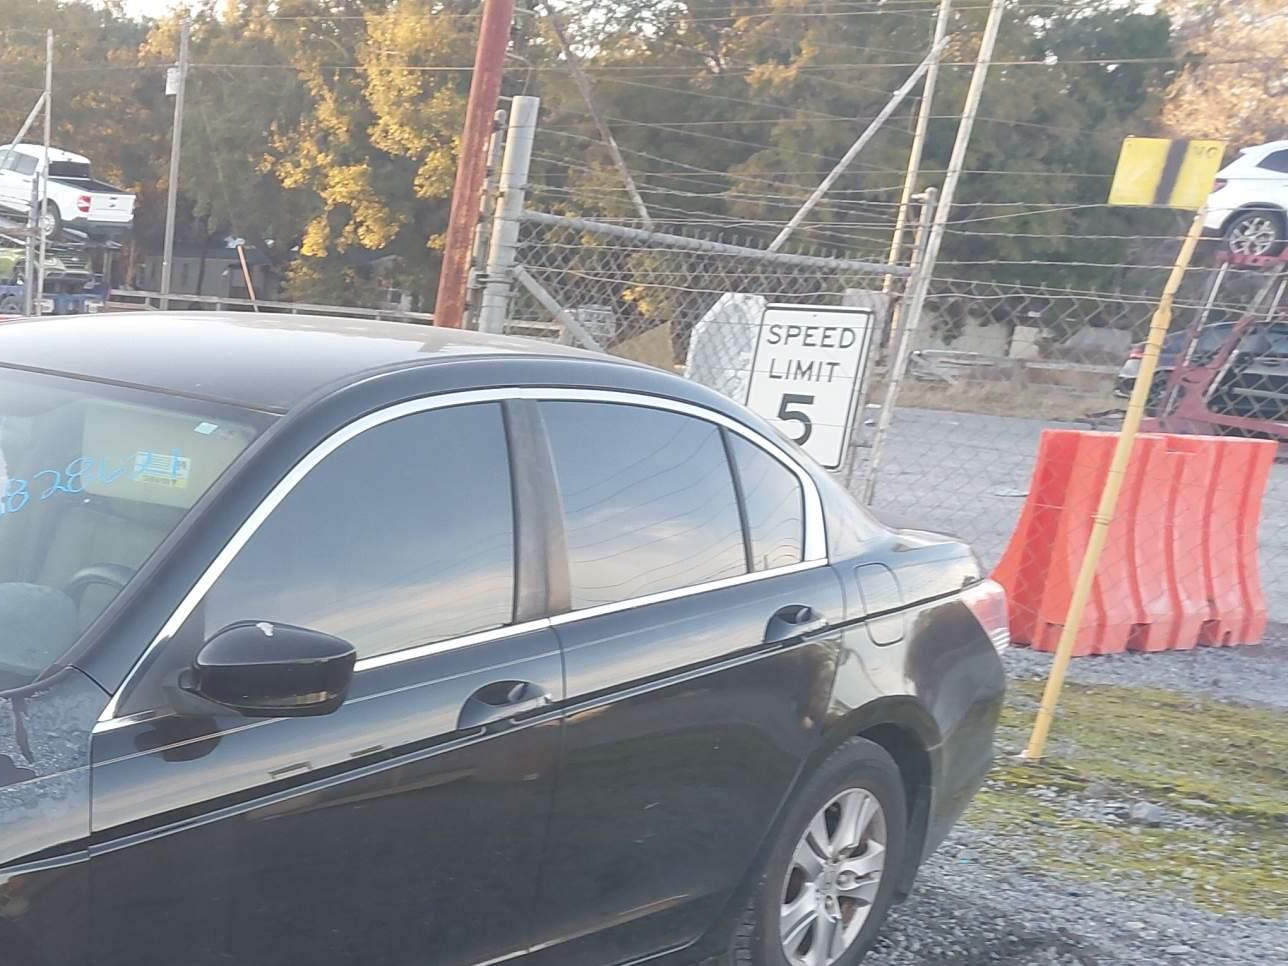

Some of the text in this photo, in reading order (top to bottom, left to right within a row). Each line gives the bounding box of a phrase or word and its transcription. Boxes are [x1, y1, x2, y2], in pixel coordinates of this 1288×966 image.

[766, 324, 856, 349] SPEED
[768, 358, 841, 383] LIMIT
[777, 393, 816, 447] 5
